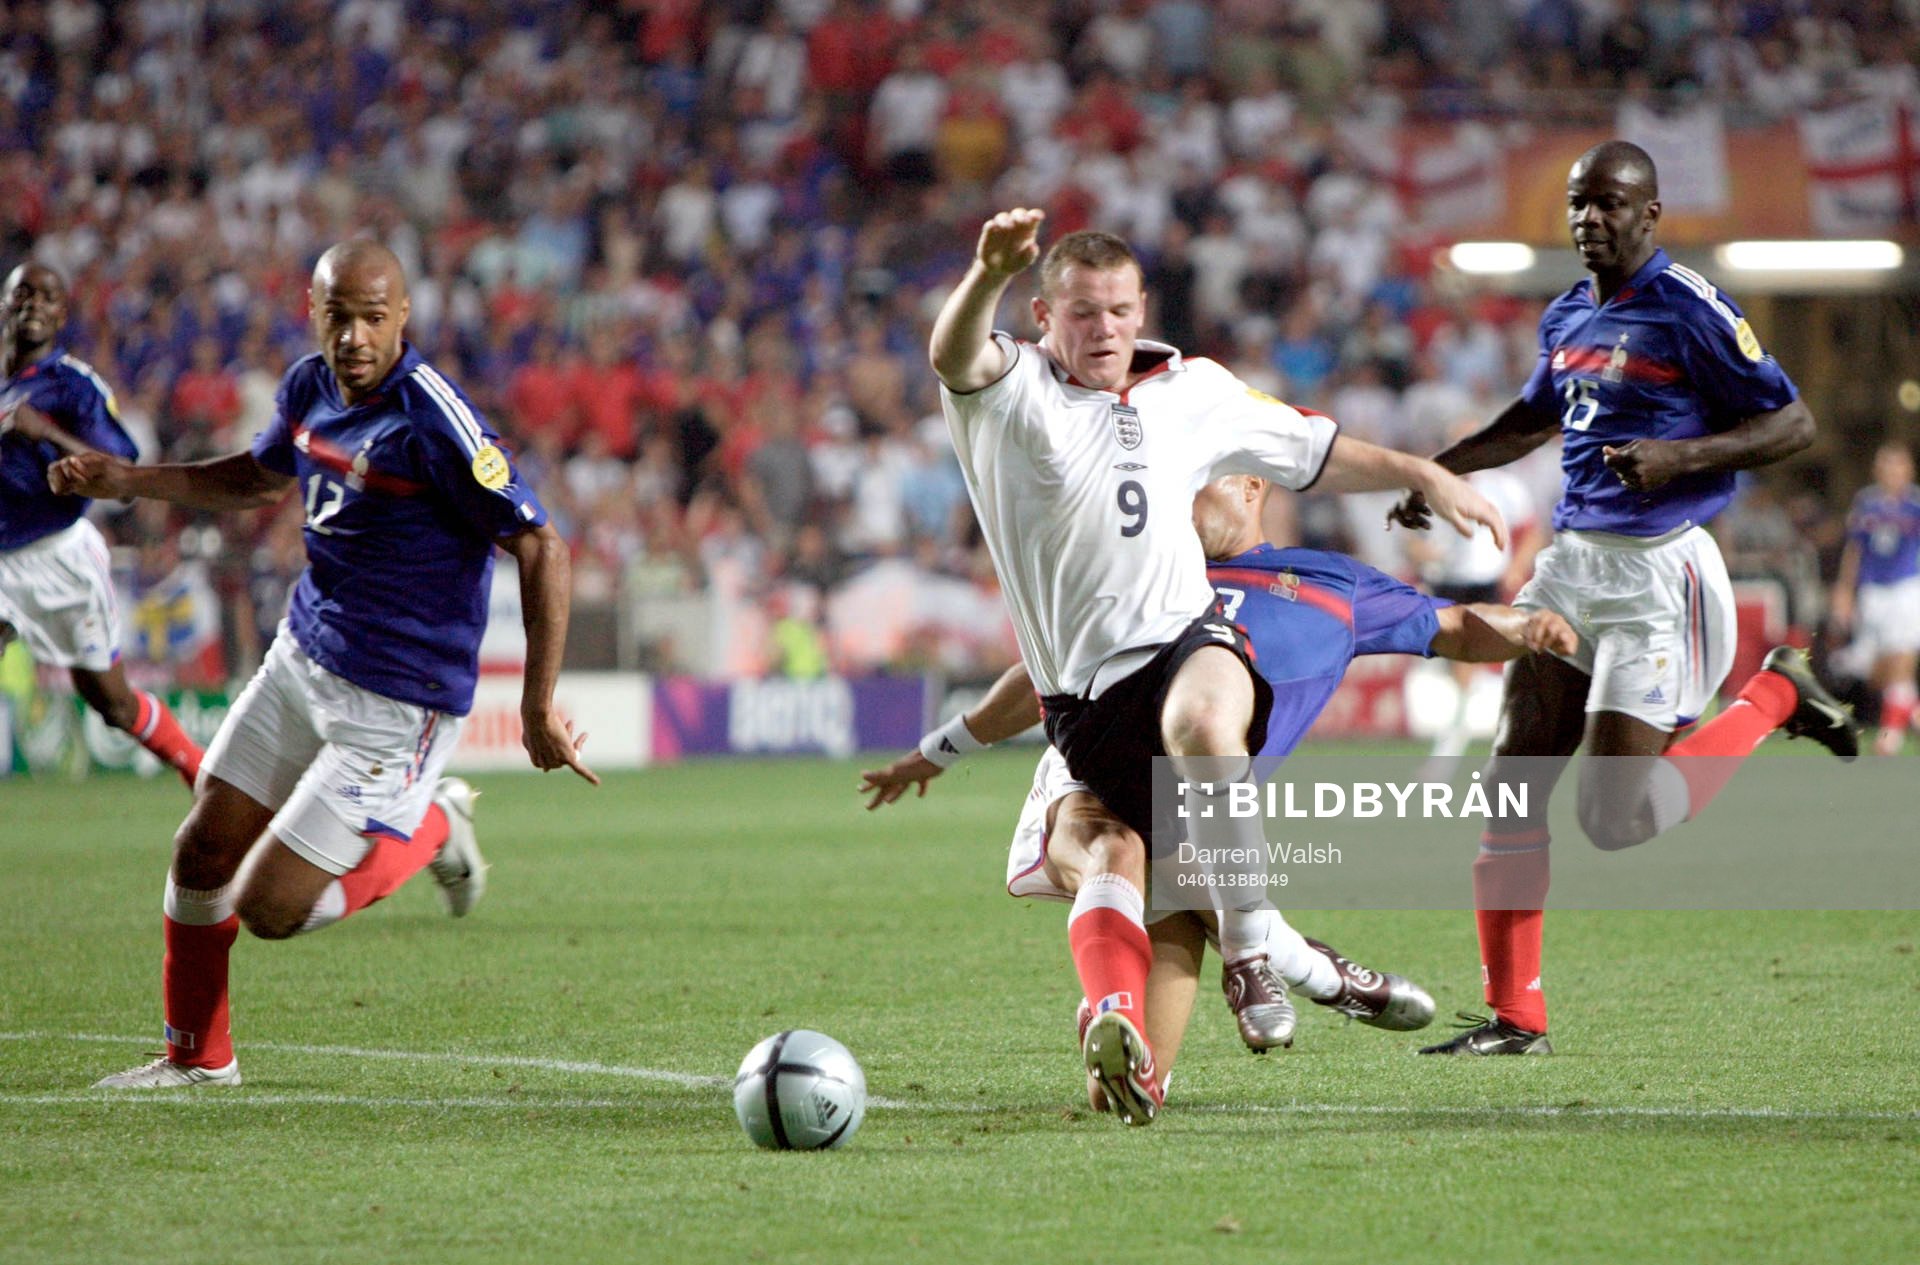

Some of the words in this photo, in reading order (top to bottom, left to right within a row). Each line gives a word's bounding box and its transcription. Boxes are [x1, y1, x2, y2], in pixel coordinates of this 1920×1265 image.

[1563, 377, 1600, 432] 15
[305, 473, 345, 537] 12
[1116, 479, 1149, 538] 9
